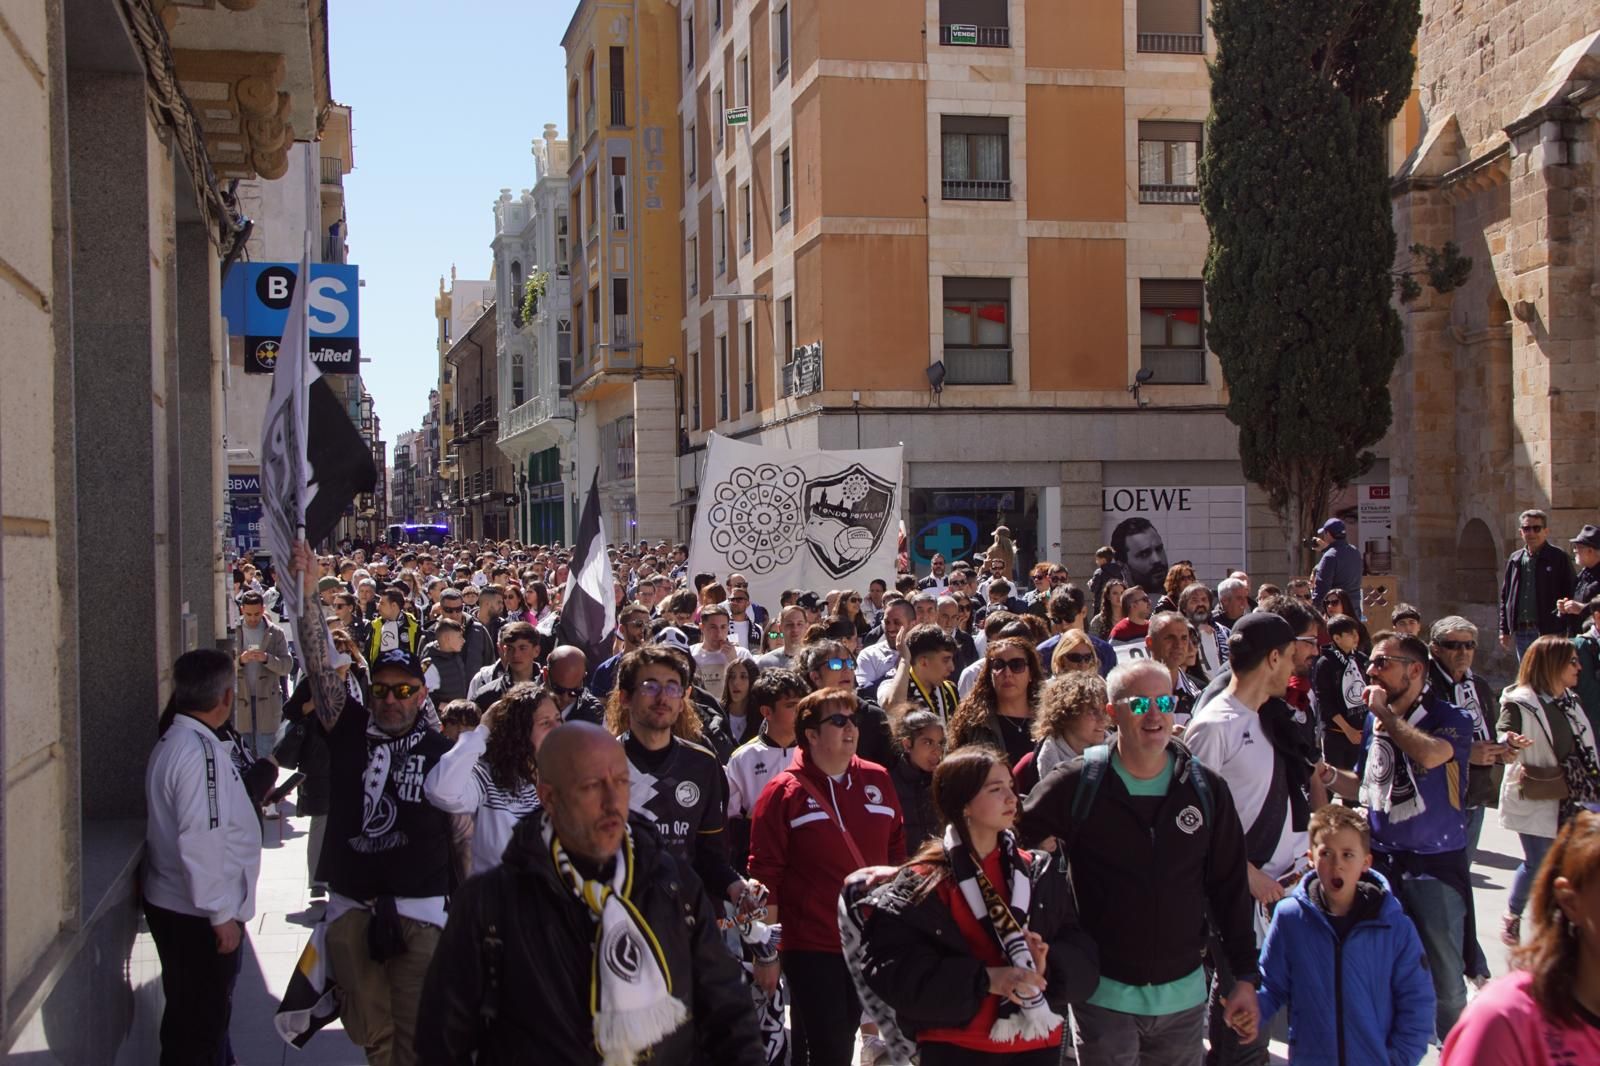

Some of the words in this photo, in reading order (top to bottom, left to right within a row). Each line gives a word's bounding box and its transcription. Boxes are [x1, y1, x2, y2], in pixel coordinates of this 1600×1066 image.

[728, 112, 748, 120] VENDE
[268, 275, 289, 299] B
[308, 276, 350, 334] S
[1101, 488, 1192, 512] LOEWE
[673, 820, 690, 837] QR
